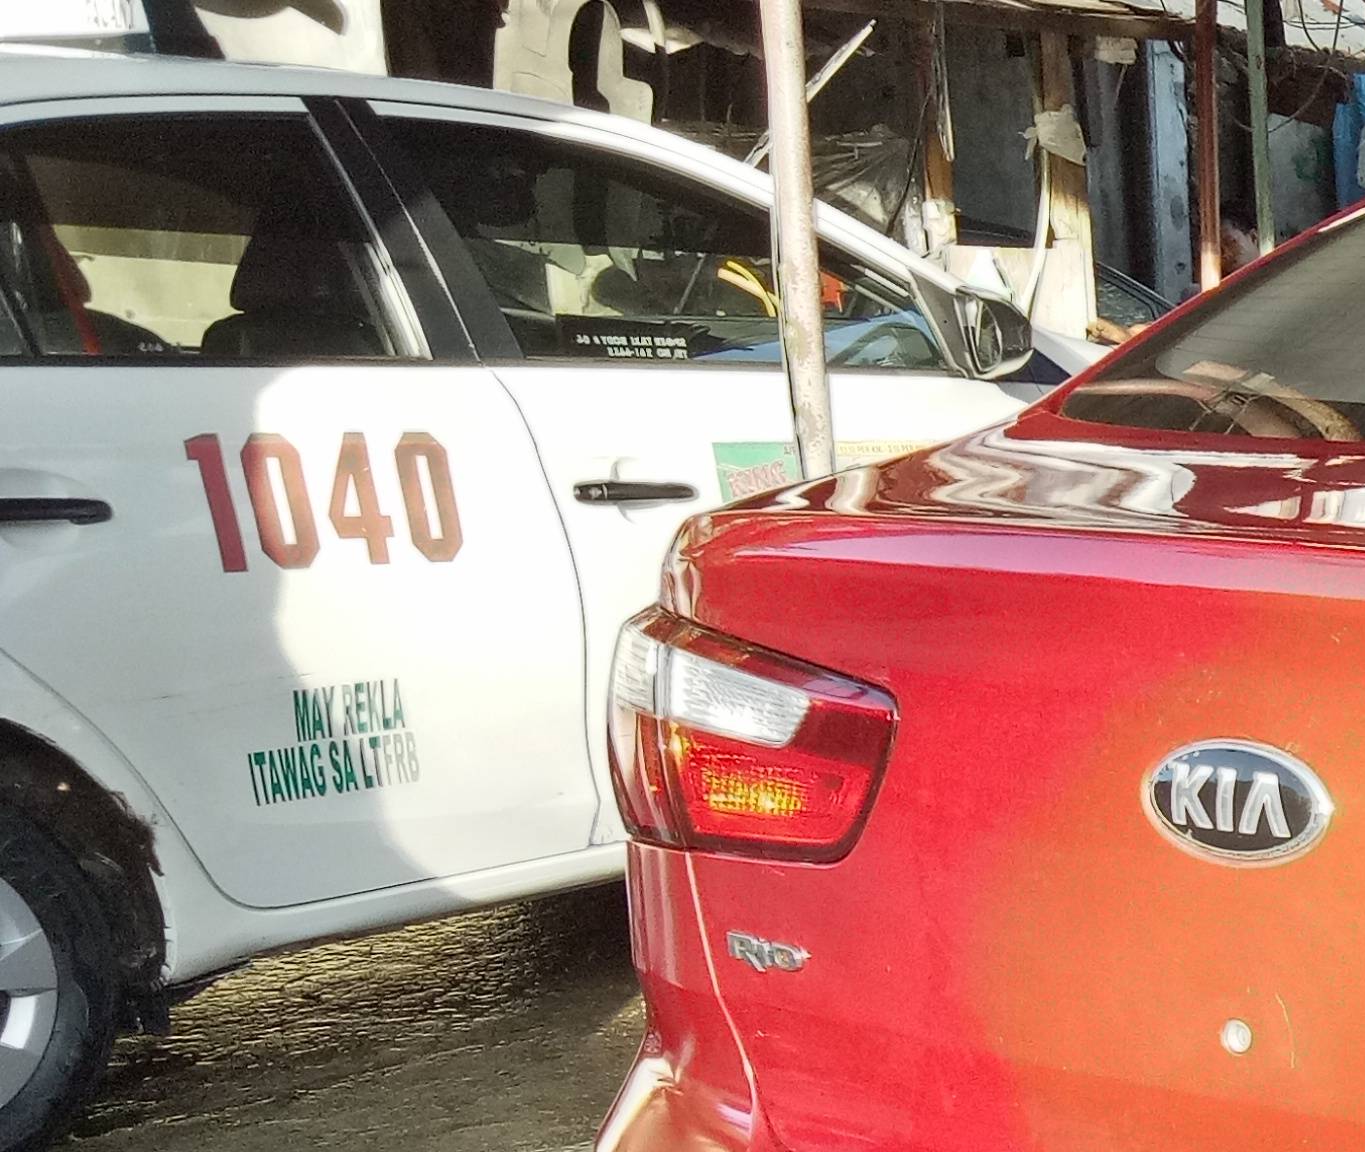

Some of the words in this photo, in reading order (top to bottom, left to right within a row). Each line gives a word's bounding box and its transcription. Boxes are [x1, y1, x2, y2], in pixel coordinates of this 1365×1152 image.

[183, 431, 464, 573] 1040
[293, 687, 335, 743] MAY
[342, 678, 406, 736] REKLA
[248, 743, 327, 807] ITAWAG
[329, 739, 359, 794] SA
[360, 731, 421, 790] LTFRB
[1171, 761, 1292, 839] KIA
[726, 931, 805, 973] Rio
